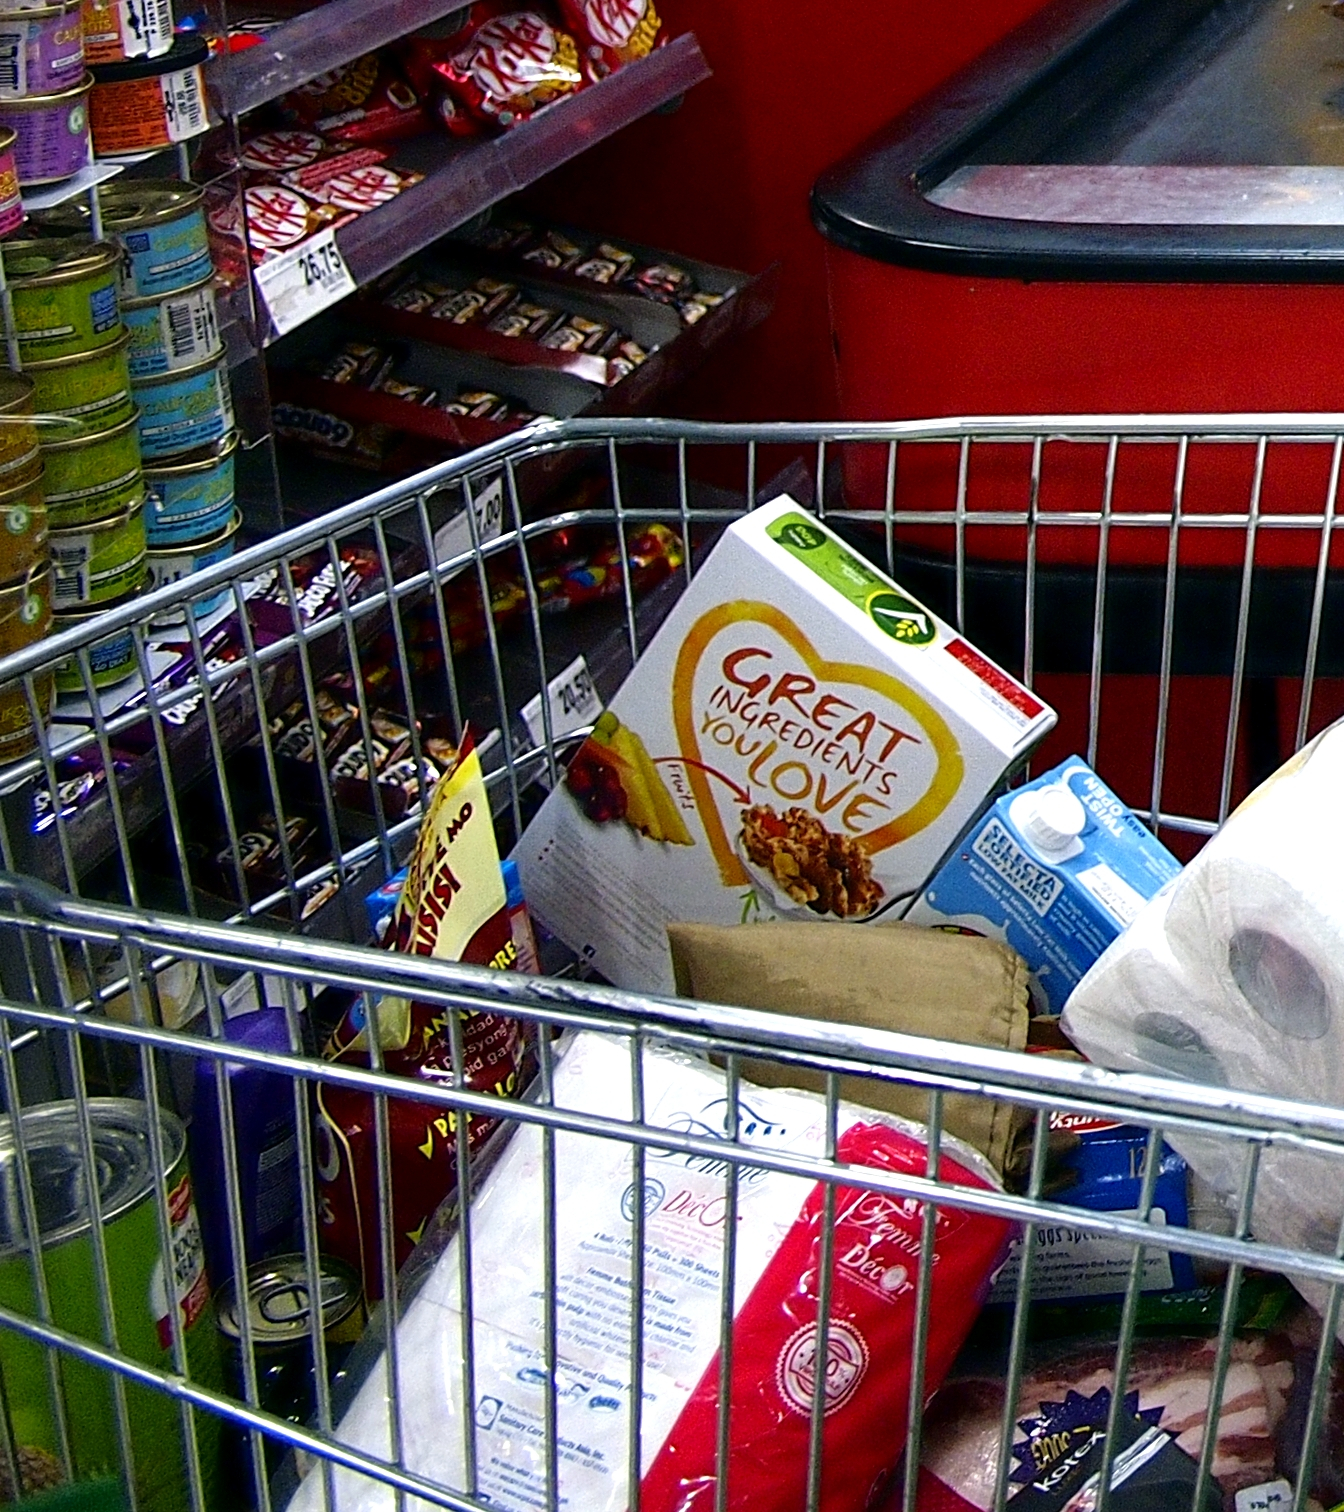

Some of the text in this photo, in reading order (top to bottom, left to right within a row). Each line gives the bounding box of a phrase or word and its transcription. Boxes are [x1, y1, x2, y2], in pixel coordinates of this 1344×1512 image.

[299, 242, 341, 286] 26.75
[722, 647, 922, 763] GREAT
[701, 711, 891, 833] YOU LOVE
[709, 685, 898, 796] INGREDIENTS
[1081, 794, 1125, 838] TWIST
[1082, 776, 1124, 816] OPEN
[982, 833, 1052, 904] FORTIFIED
[989, 824, 1059, 892] SELECTA
